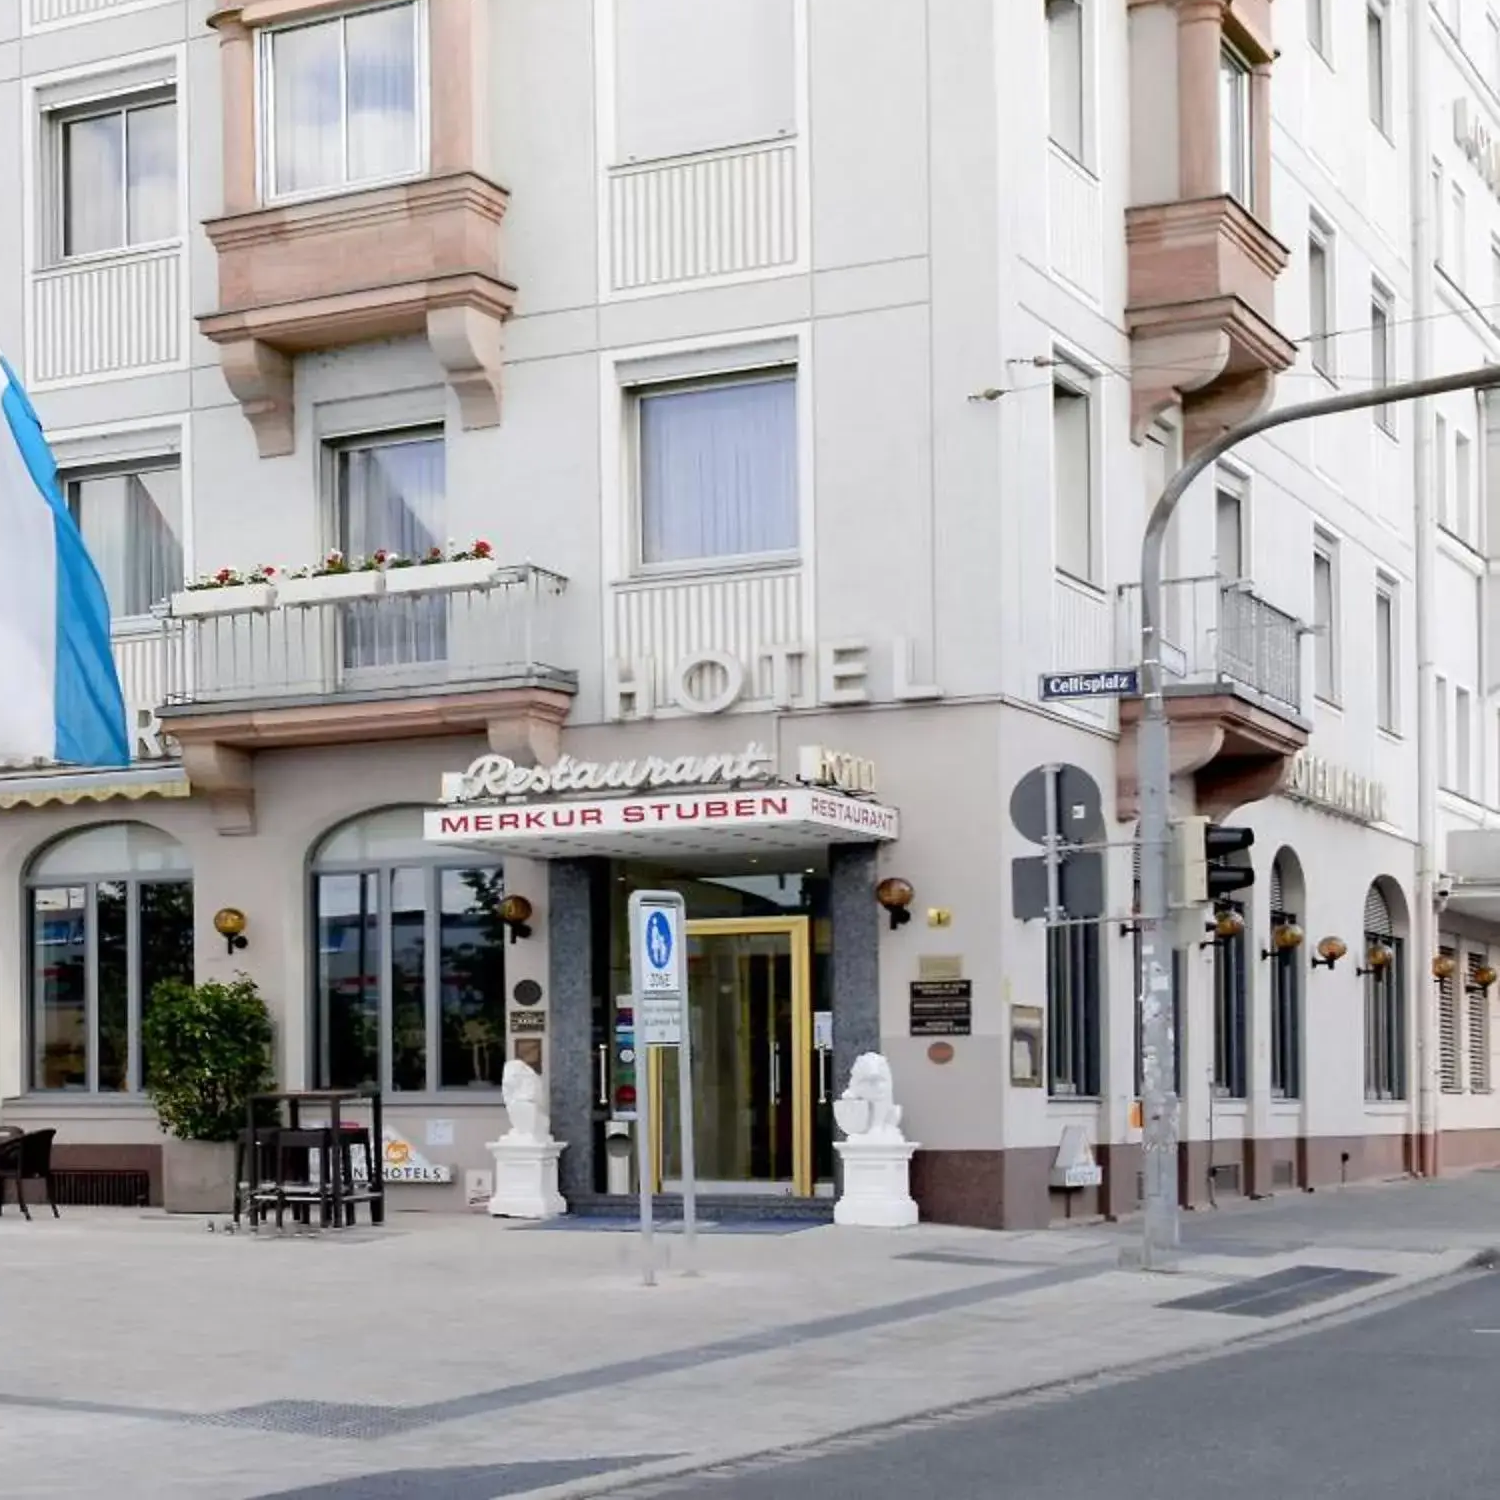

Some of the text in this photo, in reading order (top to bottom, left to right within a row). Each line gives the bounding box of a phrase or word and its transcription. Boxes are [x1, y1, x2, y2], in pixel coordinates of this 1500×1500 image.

[604, 632, 947, 724] HOTEL
[464, 740, 774, 800] Restaurant
[440, 796, 789, 834] MERKUR STUBEN
[811, 797, 894, 831] RESTAURANT
